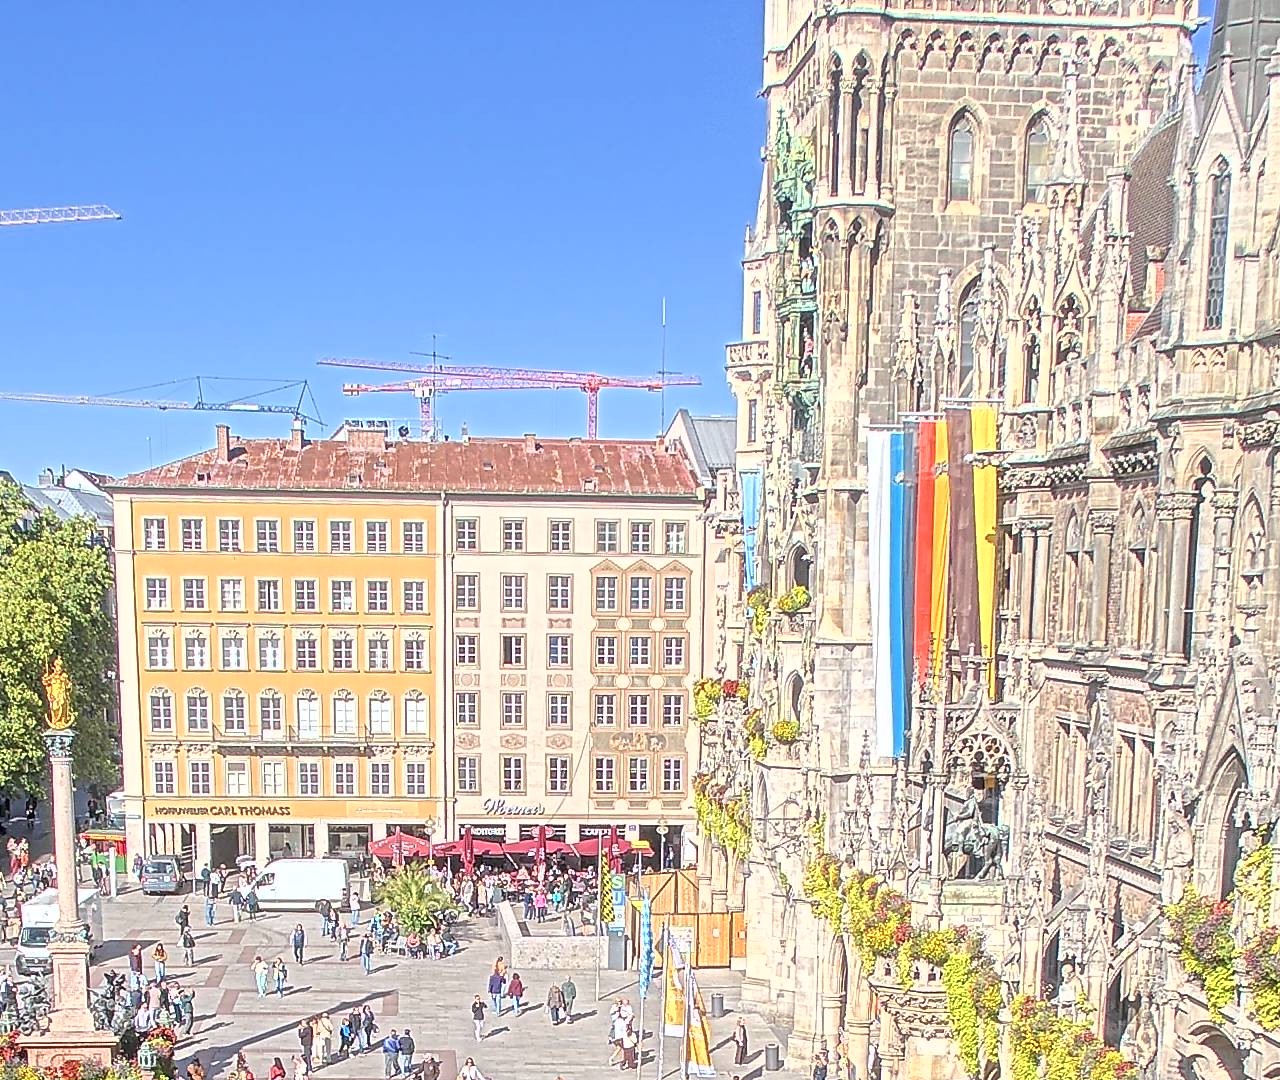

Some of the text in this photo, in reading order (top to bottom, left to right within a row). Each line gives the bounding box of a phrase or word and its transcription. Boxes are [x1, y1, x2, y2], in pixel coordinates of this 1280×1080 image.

[209, 805, 238, 816] CARL
[238, 805, 291, 816] THOMASS
[611, 876, 623, 889] S
